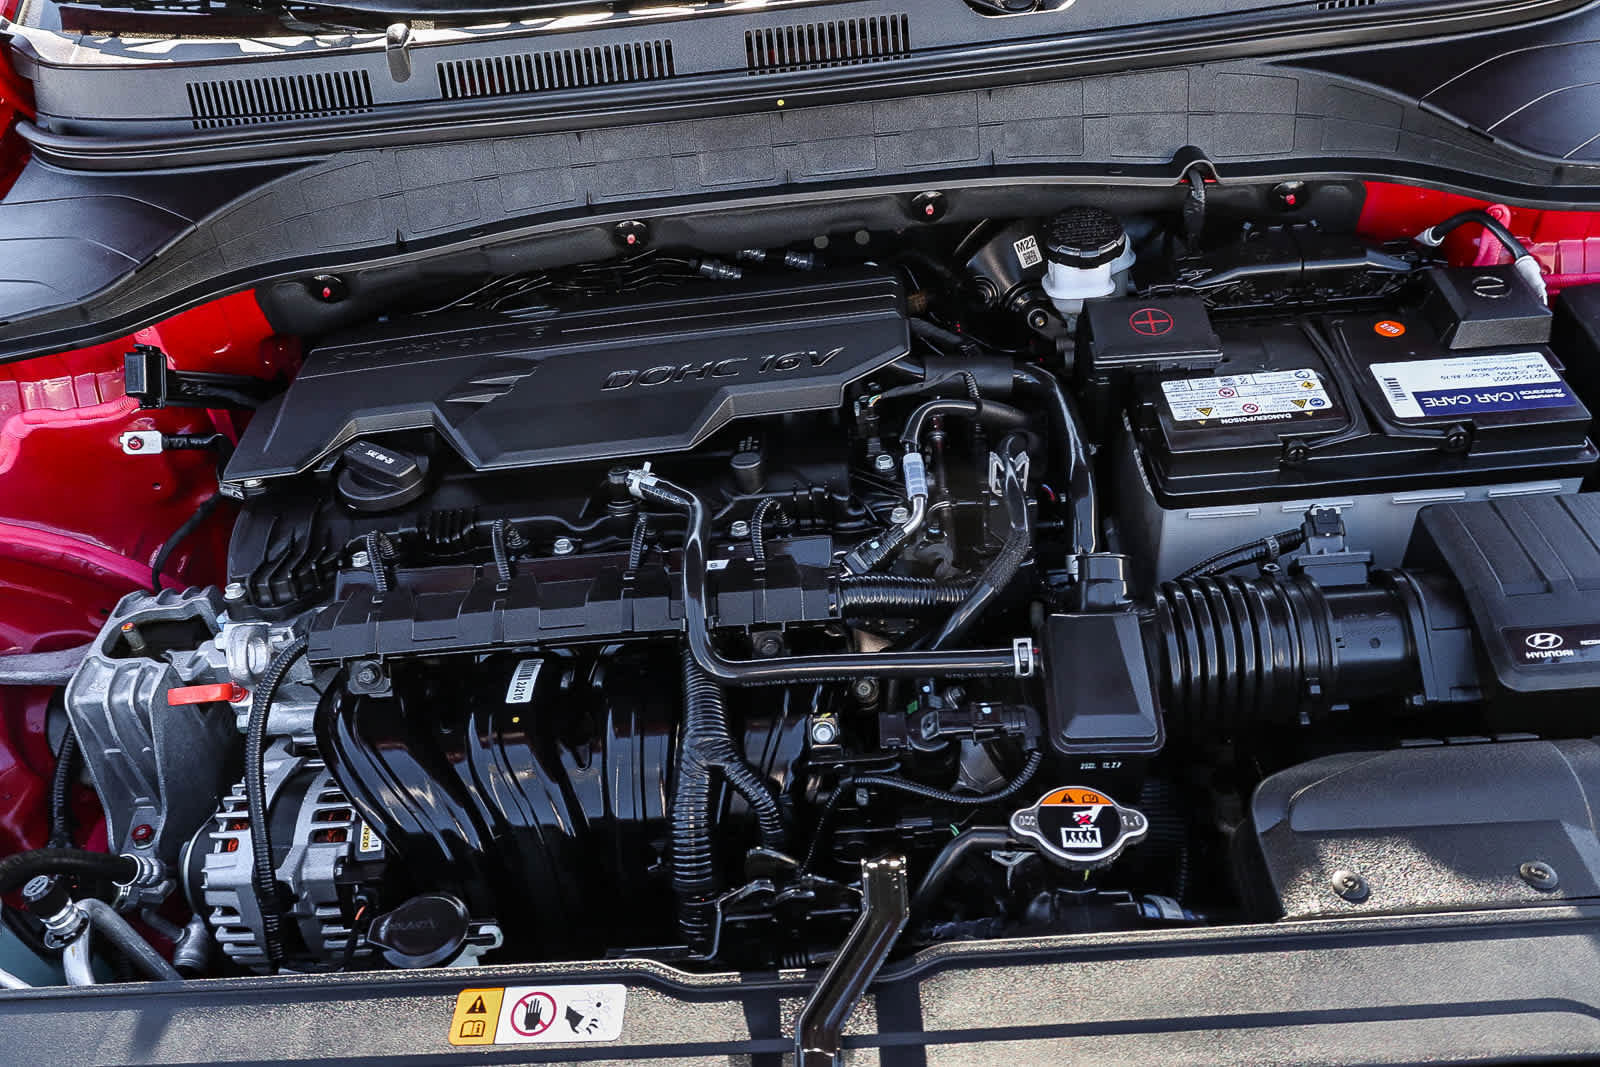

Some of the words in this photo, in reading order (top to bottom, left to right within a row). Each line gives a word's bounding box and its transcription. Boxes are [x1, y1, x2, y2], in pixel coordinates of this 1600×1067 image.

[1016, 238, 1036, 253] M22
[600, 357, 749, 392] DOHC
[758, 347, 845, 374] 16V
[1421, 395, 1472, 408] CARE
[1475, 391, 1514, 404] CAR
[1220, 413, 1292, 425] DANGER/POISON
[1525, 649, 1575, 660] HYUNDAI
[512, 681, 528, 701] 2J210
[1121, 815, 1141, 827] 1.1
